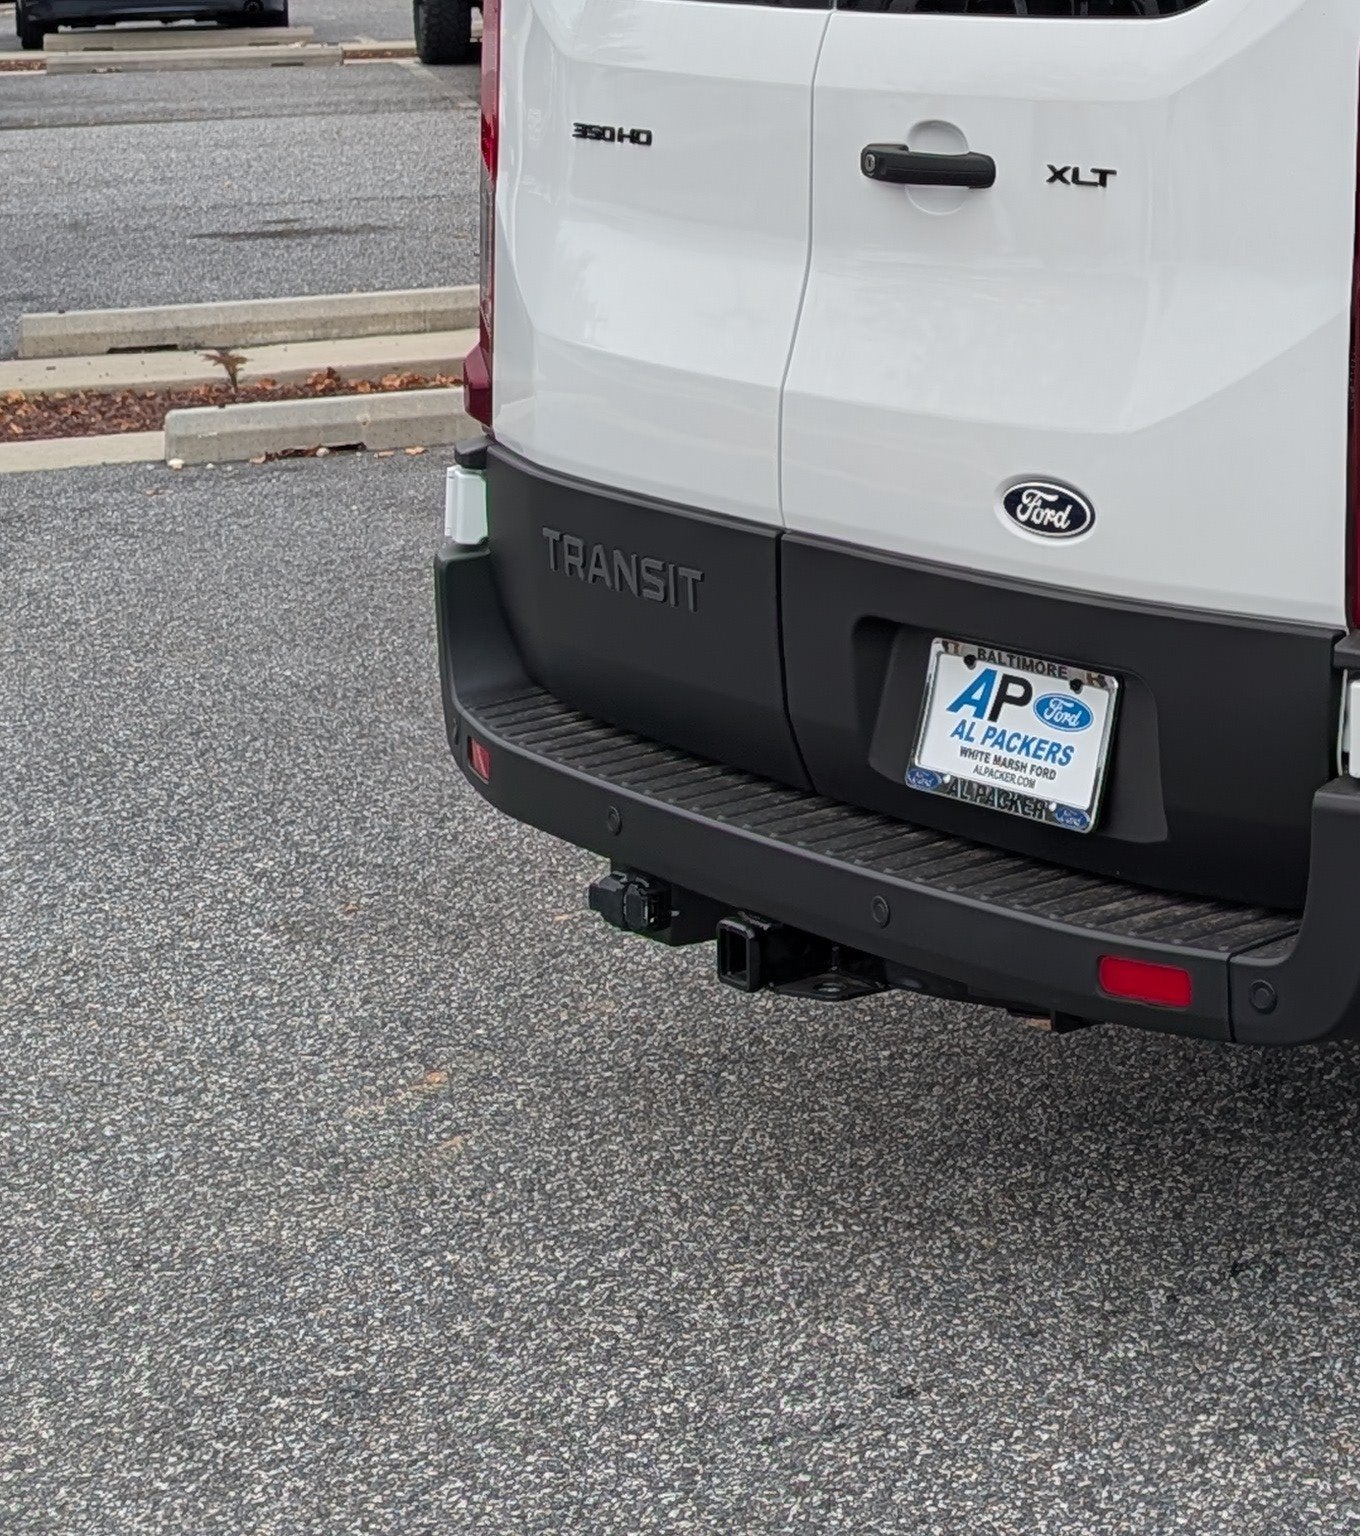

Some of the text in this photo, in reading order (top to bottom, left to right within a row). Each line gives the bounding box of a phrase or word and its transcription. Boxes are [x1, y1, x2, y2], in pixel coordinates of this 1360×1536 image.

[1045, 164, 1118, 188] XLT
[1016, 488, 1073, 530] Ford
[542, 526, 704, 613] TRANSIT
[977, 647, 1068, 680] BALTIMORE
[945, 667, 1034, 723] AP
[1043, 697, 1082, 727] Ford
[950, 718, 1075, 767] AL PACKERS
[960, 745, 1057, 781] WHITE MARSH FORD
[973, 764, 1037, 790] ALPACKER.COM
